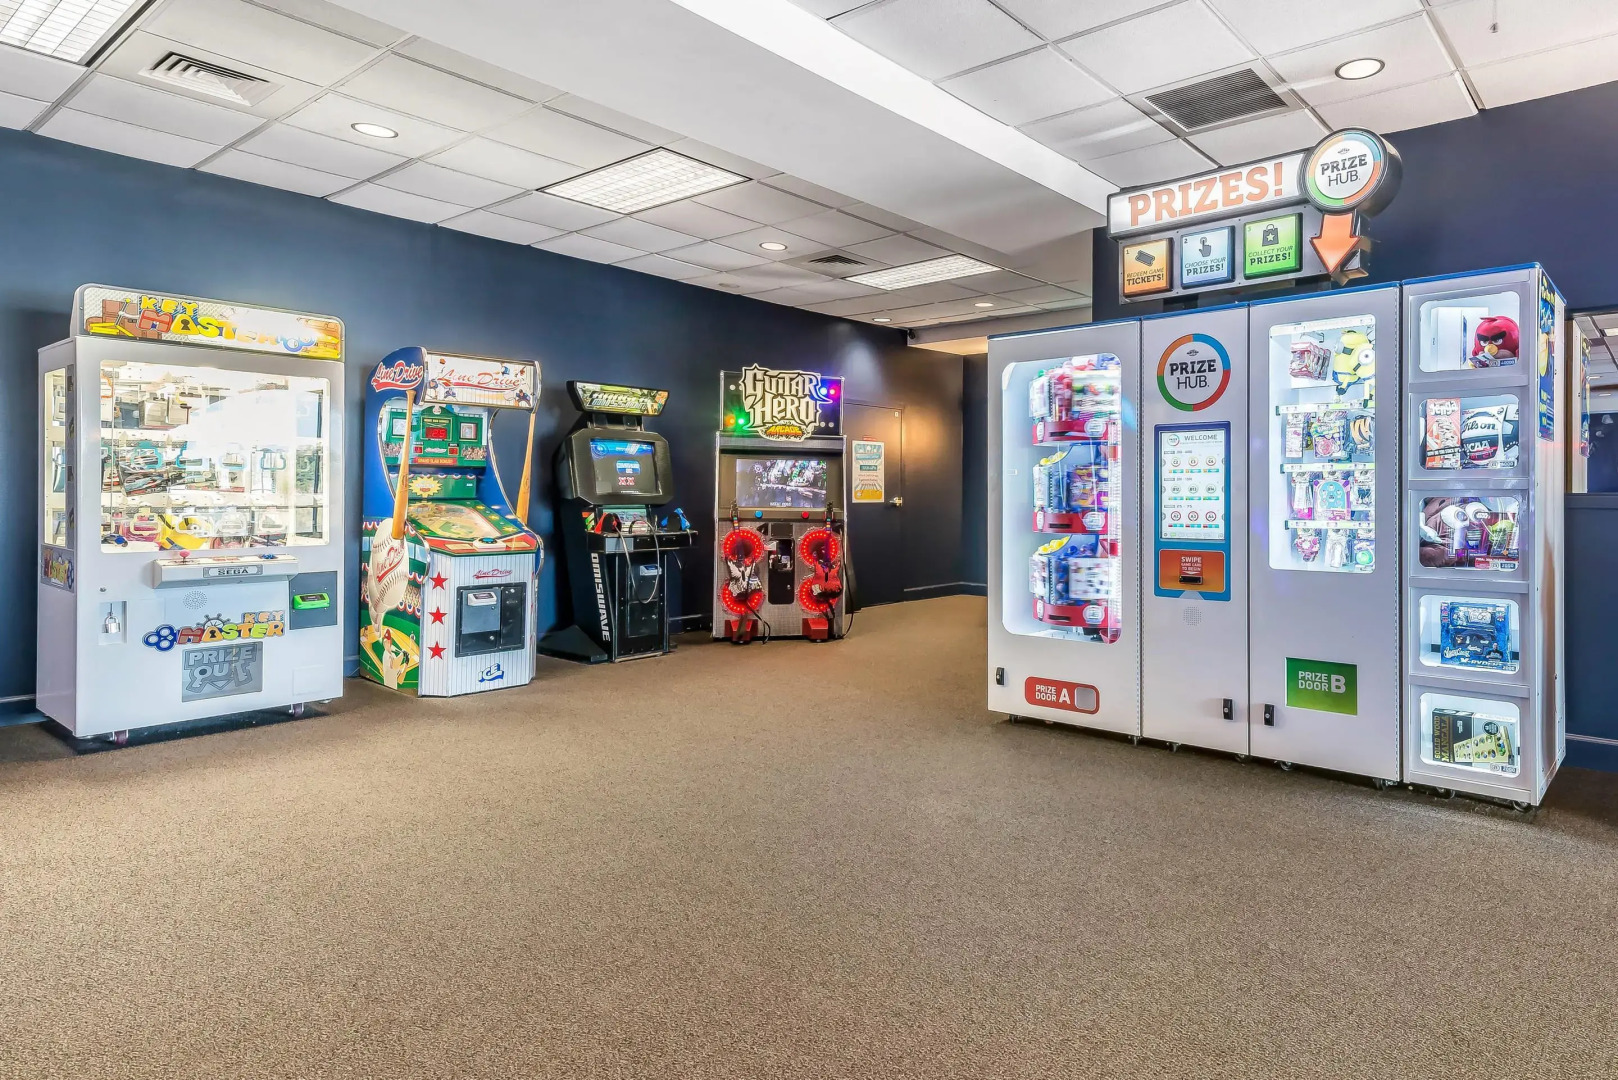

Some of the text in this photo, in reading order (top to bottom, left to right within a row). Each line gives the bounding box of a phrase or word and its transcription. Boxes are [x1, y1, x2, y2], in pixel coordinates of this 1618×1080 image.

[1320, 154, 1367, 175] PRIZE
[1128, 161, 1283, 227] PRIZES!
[1248, 245, 1293, 258] COLLECT YOUR
[1184, 257, 1226, 269] CHOOSE YOUR
[1250, 253, 1291, 266] PRIZES!
[1126, 269, 1148, 278] REDEEM
[1186, 263, 1224, 276] PRIZES!
[1126, 274, 1164, 286] TICKETS!
[139, 295, 198, 316] KEY
[372, 360, 424, 383] Line Drive
[1169, 359, 1216, 376] PRIZE
[437, 369, 520, 387] Line Drive
[744, 369, 823, 412] GUITAR
[751, 392, 817, 427] HERO
[766, 425, 803, 436] ARCADE
[217, 568, 249, 576] SEGA
[244, 610, 284, 624] KEY
[177, 621, 284, 645] MASTER
[188, 646, 253, 665] PRIZE
[478, 662, 504, 682] ICE
[1298, 671, 1328, 682] PRIZE
[1035, 684, 1056, 694] PRIZE
[1298, 680, 1328, 691] DOOR
[1330, 674, 1346, 693] B
[1035, 692, 1056, 702] DOOR
[1058, 688, 1071, 704] A
